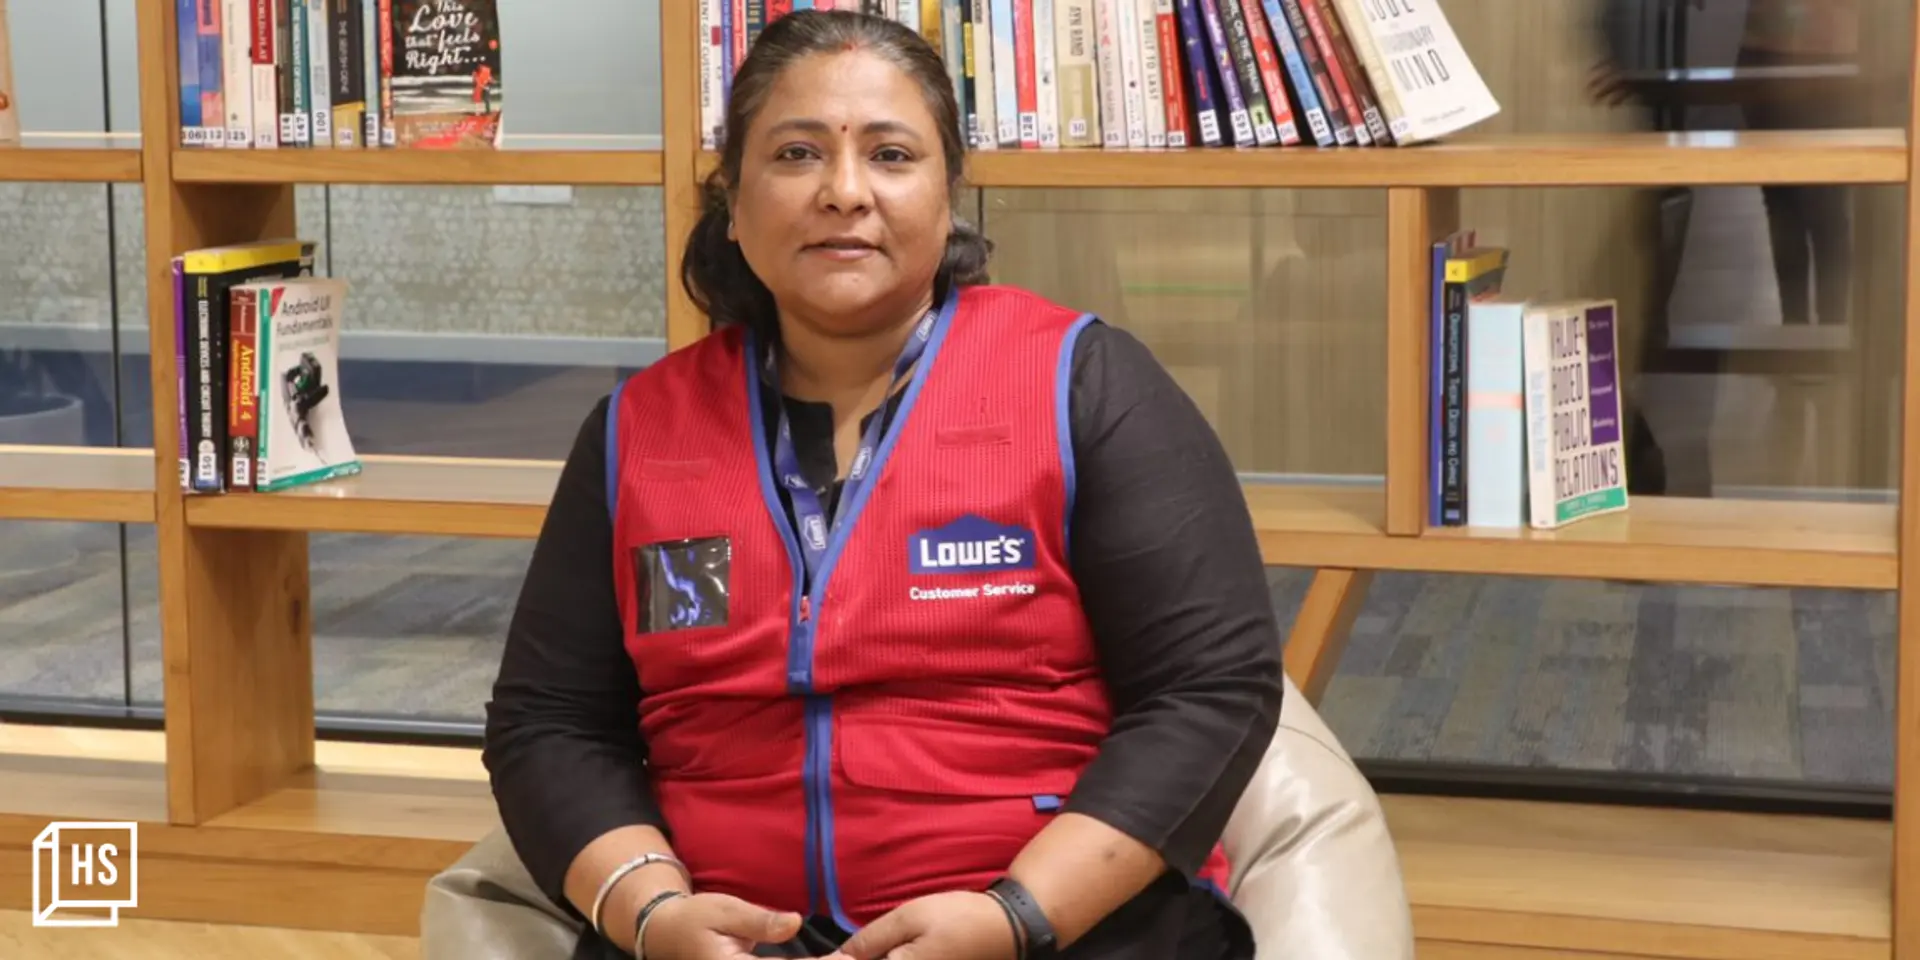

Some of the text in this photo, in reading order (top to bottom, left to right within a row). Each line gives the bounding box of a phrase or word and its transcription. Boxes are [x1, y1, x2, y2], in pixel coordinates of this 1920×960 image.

[408, 4, 479, 32] Love
[405, 27, 481, 52] that feels
[1070, 29, 1083, 57] RAND
[316, 111, 327, 133] 100
[281, 296, 317, 317] Android
[240, 345, 255, 421] Android 4
[202, 455, 213, 477] 150
[1555, 448, 1618, 501] RELATIONS
[909, 581, 1036, 601] Customer Service
